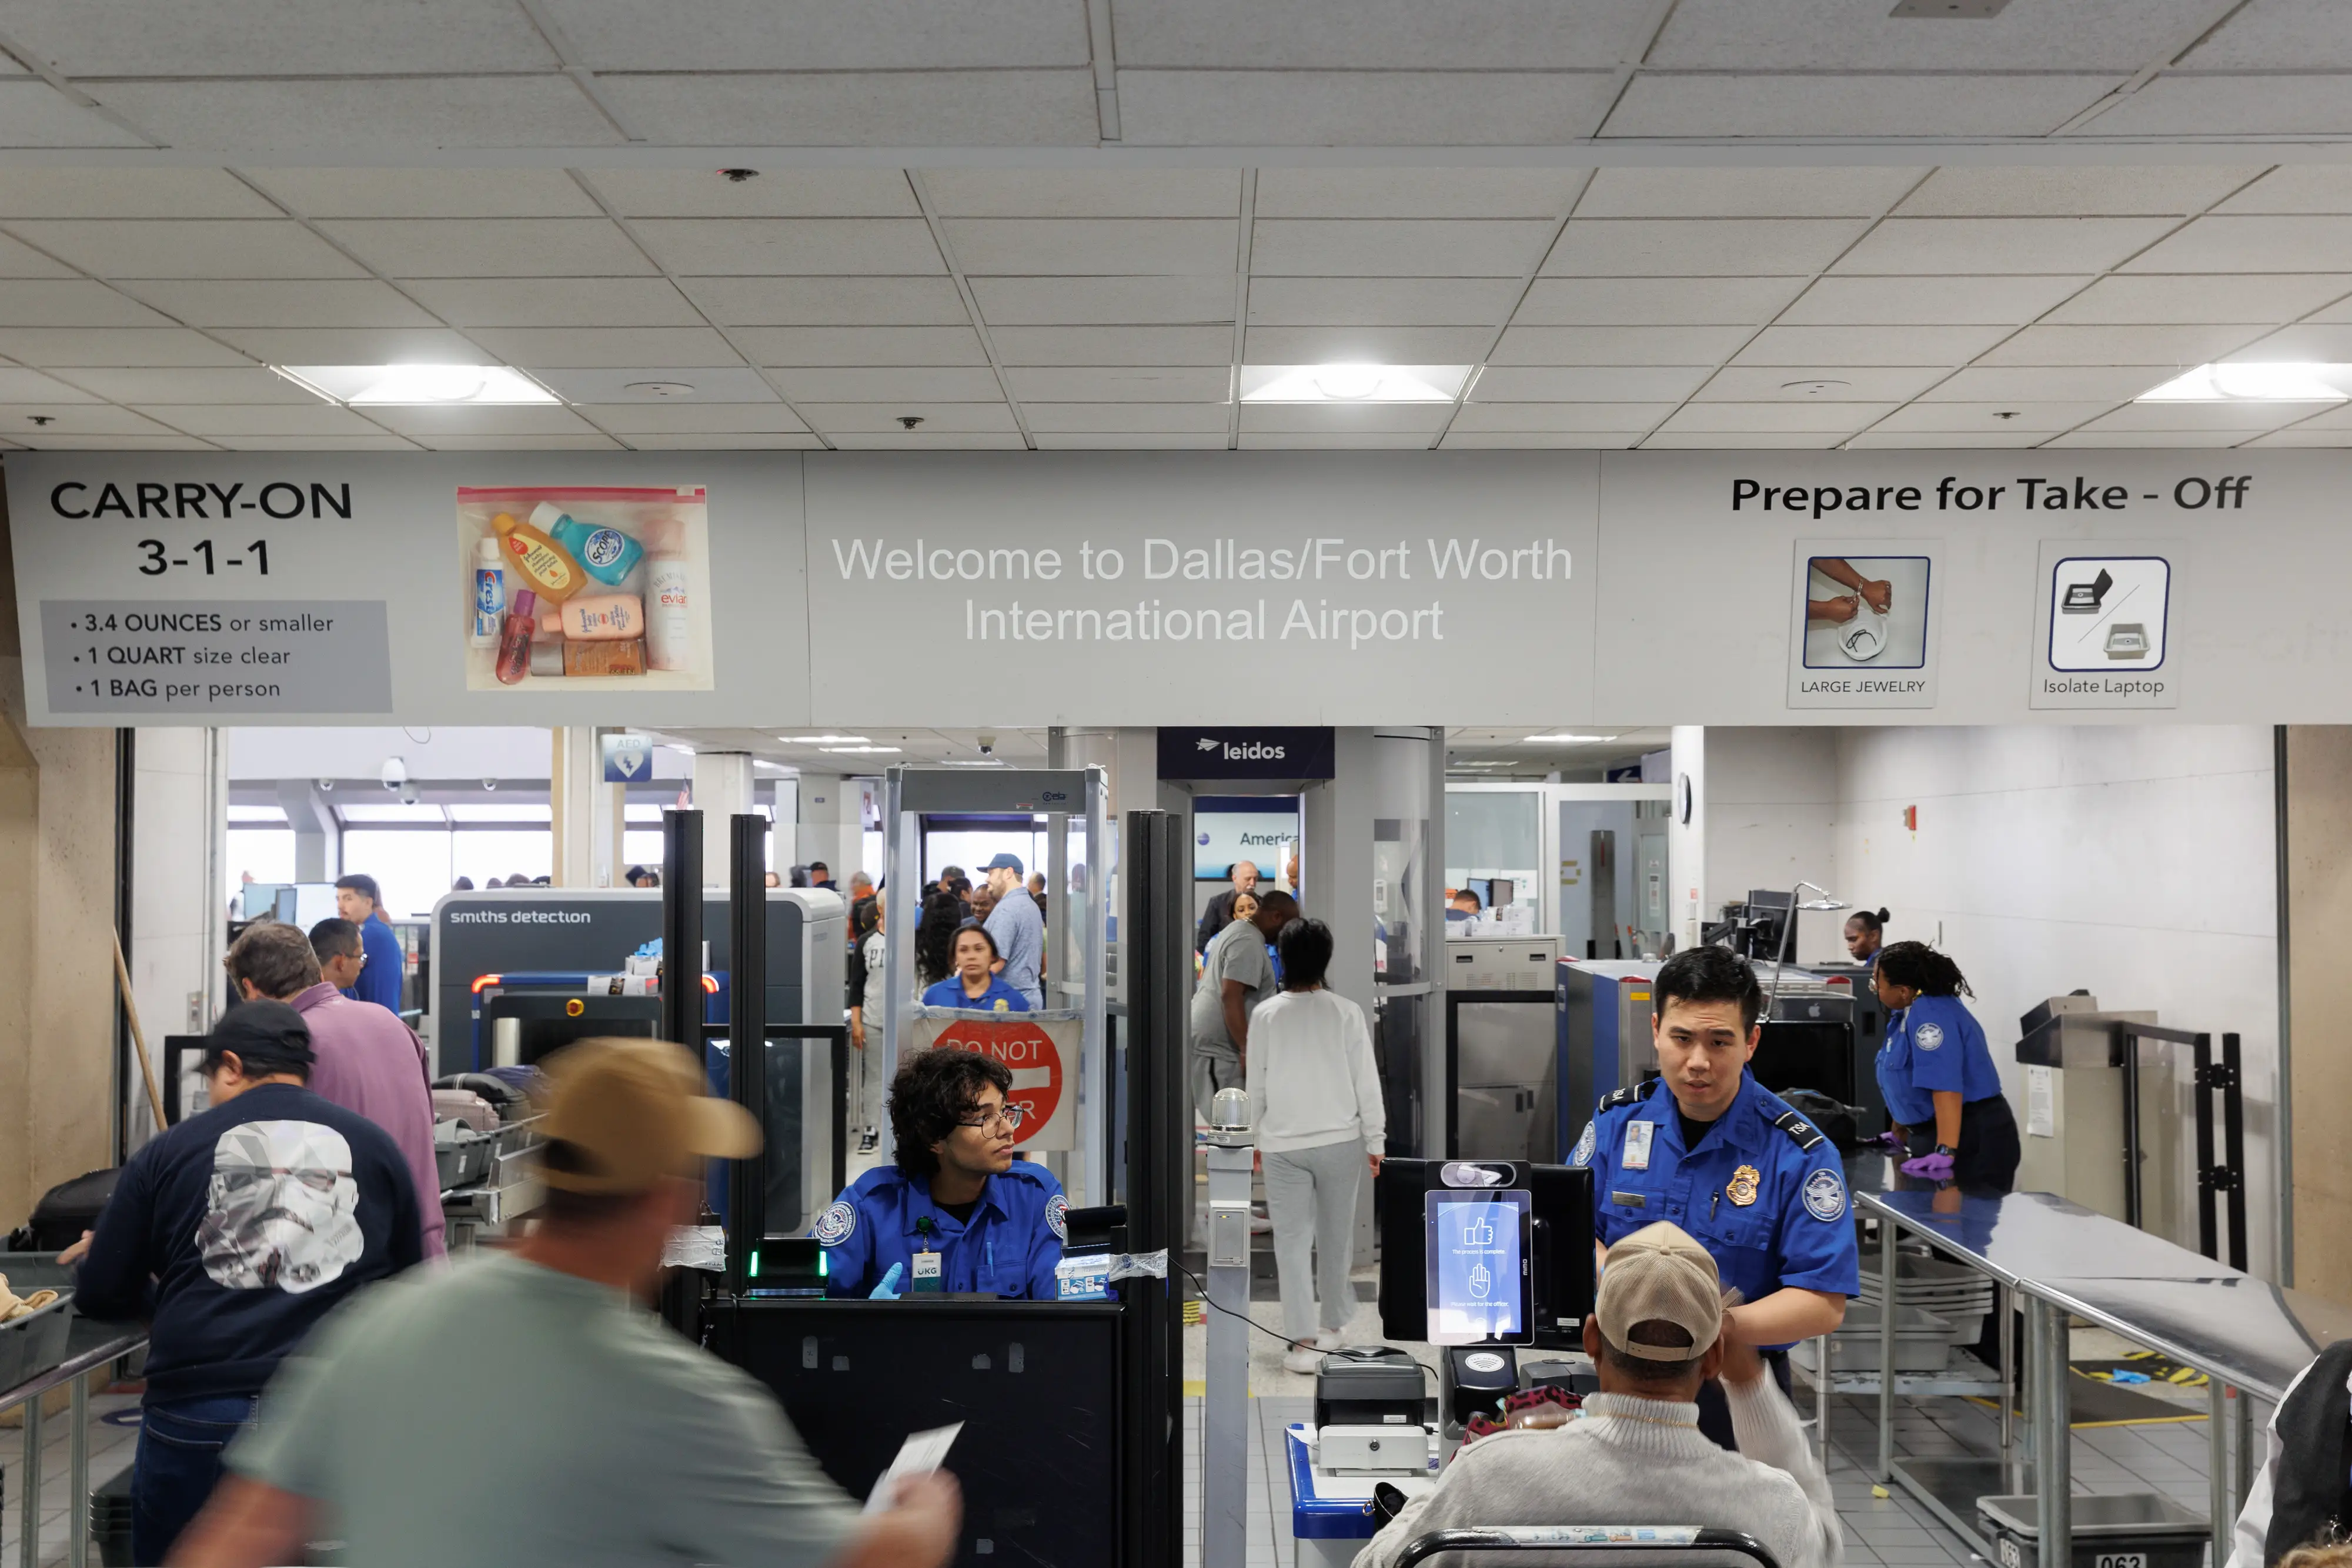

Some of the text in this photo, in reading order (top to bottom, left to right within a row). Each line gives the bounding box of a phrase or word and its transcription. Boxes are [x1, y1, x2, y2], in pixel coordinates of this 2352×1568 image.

[51, 482, 351, 519] CARRY-ON
[1732, 479, 1922, 520] Prepare
[1936, 476, 2006, 510] for
[2016, 476, 2128, 510] Take
[2174, 476, 2252, 509] Off
[593, 530, 612, 563] SCOPE
[138, 539, 268, 576] 3-1-1
[831, 538, 1572, 580] Welcome to Dallas/Fort Worth
[485, 571, 496, 615] Crest
[85, 613, 334, 632] 3.4 OUNCES or smaller
[967, 599, 1444, 650] International Airport
[88, 646, 290, 665] 1 QUART size clear
[91, 678, 280, 703] 1 BAG per person
[1802, 681, 1926, 693] LARGE JEWELRY
[2044, 678, 2164, 698] Isolate Laptop
[617, 740, 640, 748] AED
[1224, 741, 1285, 760] leidos
[450, 911, 591, 923] smiths detection
[991, 1040, 1043, 1061] NOT
[1611, 1088, 1626, 1101] TSA
[1788, 1122, 1811, 1135] TSA
